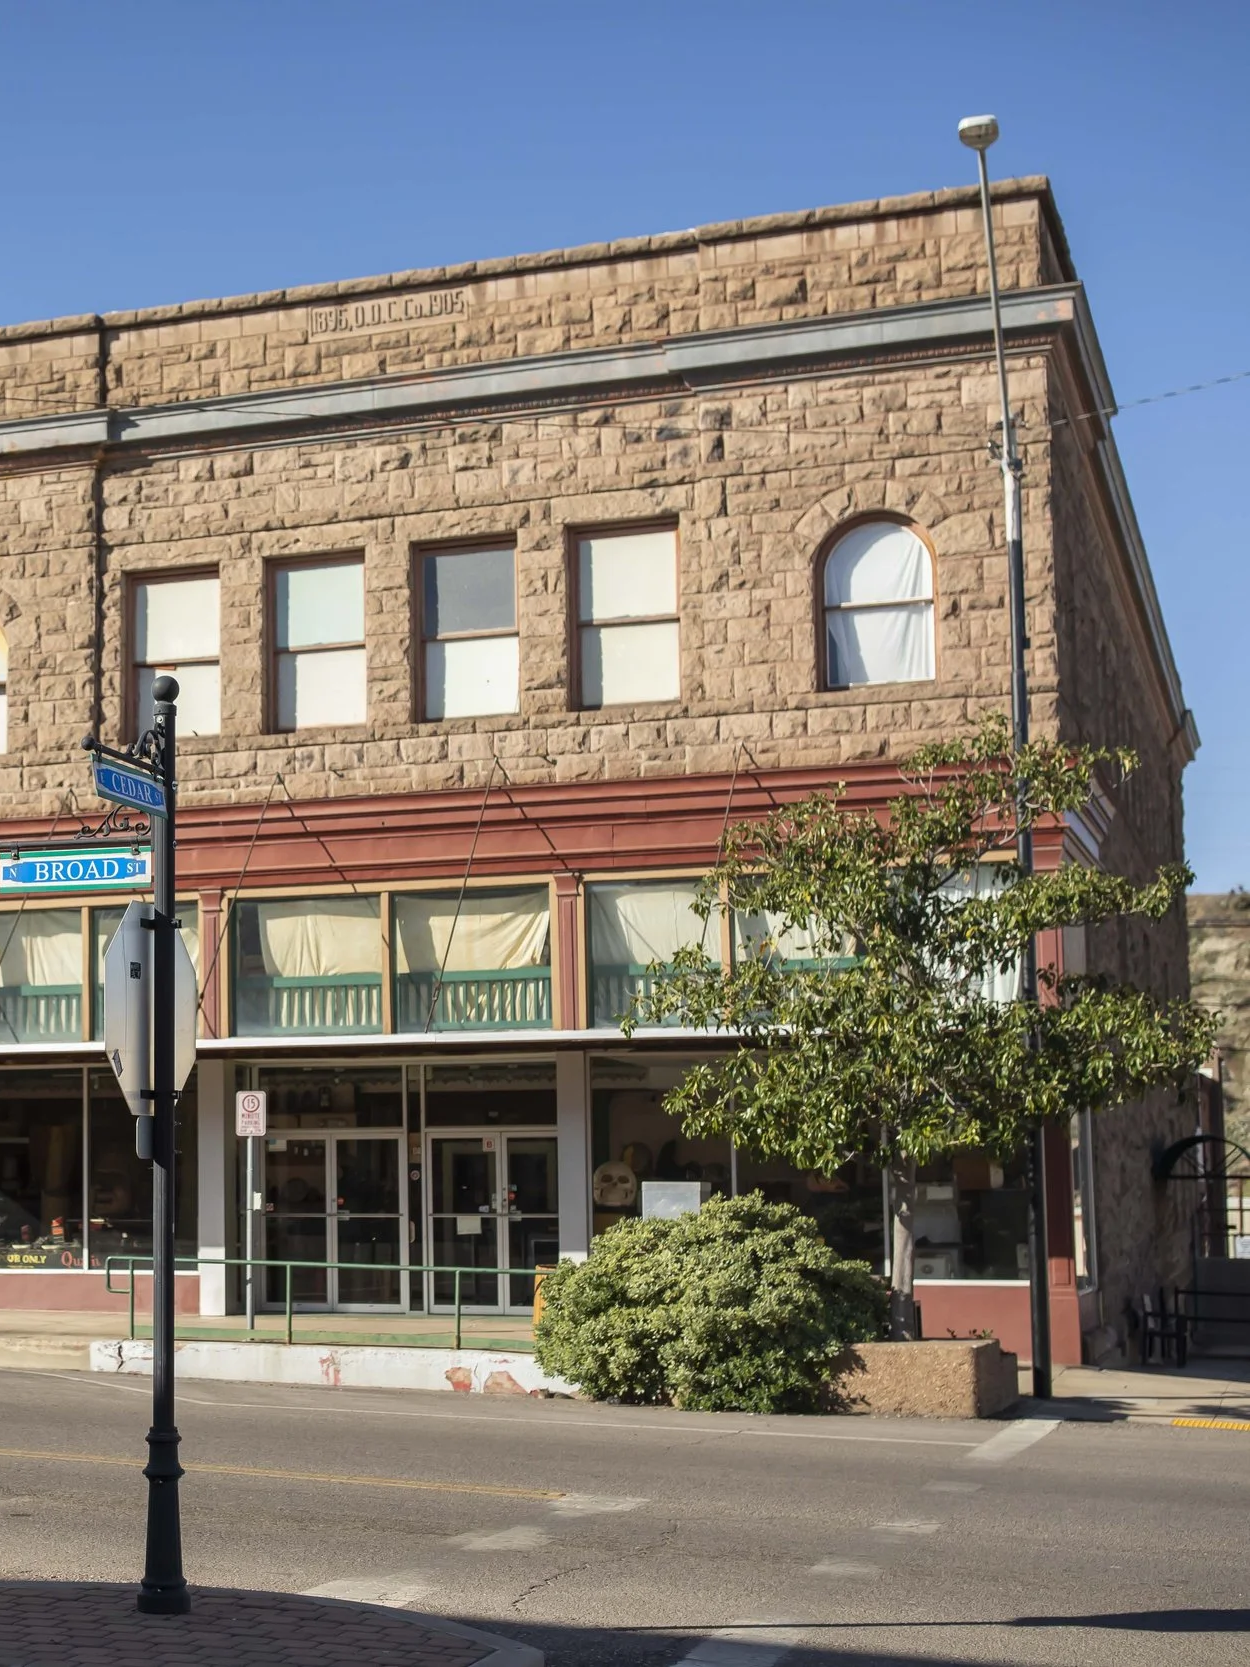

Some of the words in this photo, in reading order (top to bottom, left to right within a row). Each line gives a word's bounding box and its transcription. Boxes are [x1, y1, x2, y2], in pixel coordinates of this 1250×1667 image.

[111, 773, 153, 803] CEDAR
[9, 867, 18, 879] N
[34, 859, 120, 881] BROAD
[126, 862, 142, 874] ST
[247, 1098, 256, 1109] 15
[22, 1254, 47, 1264] ONLY
